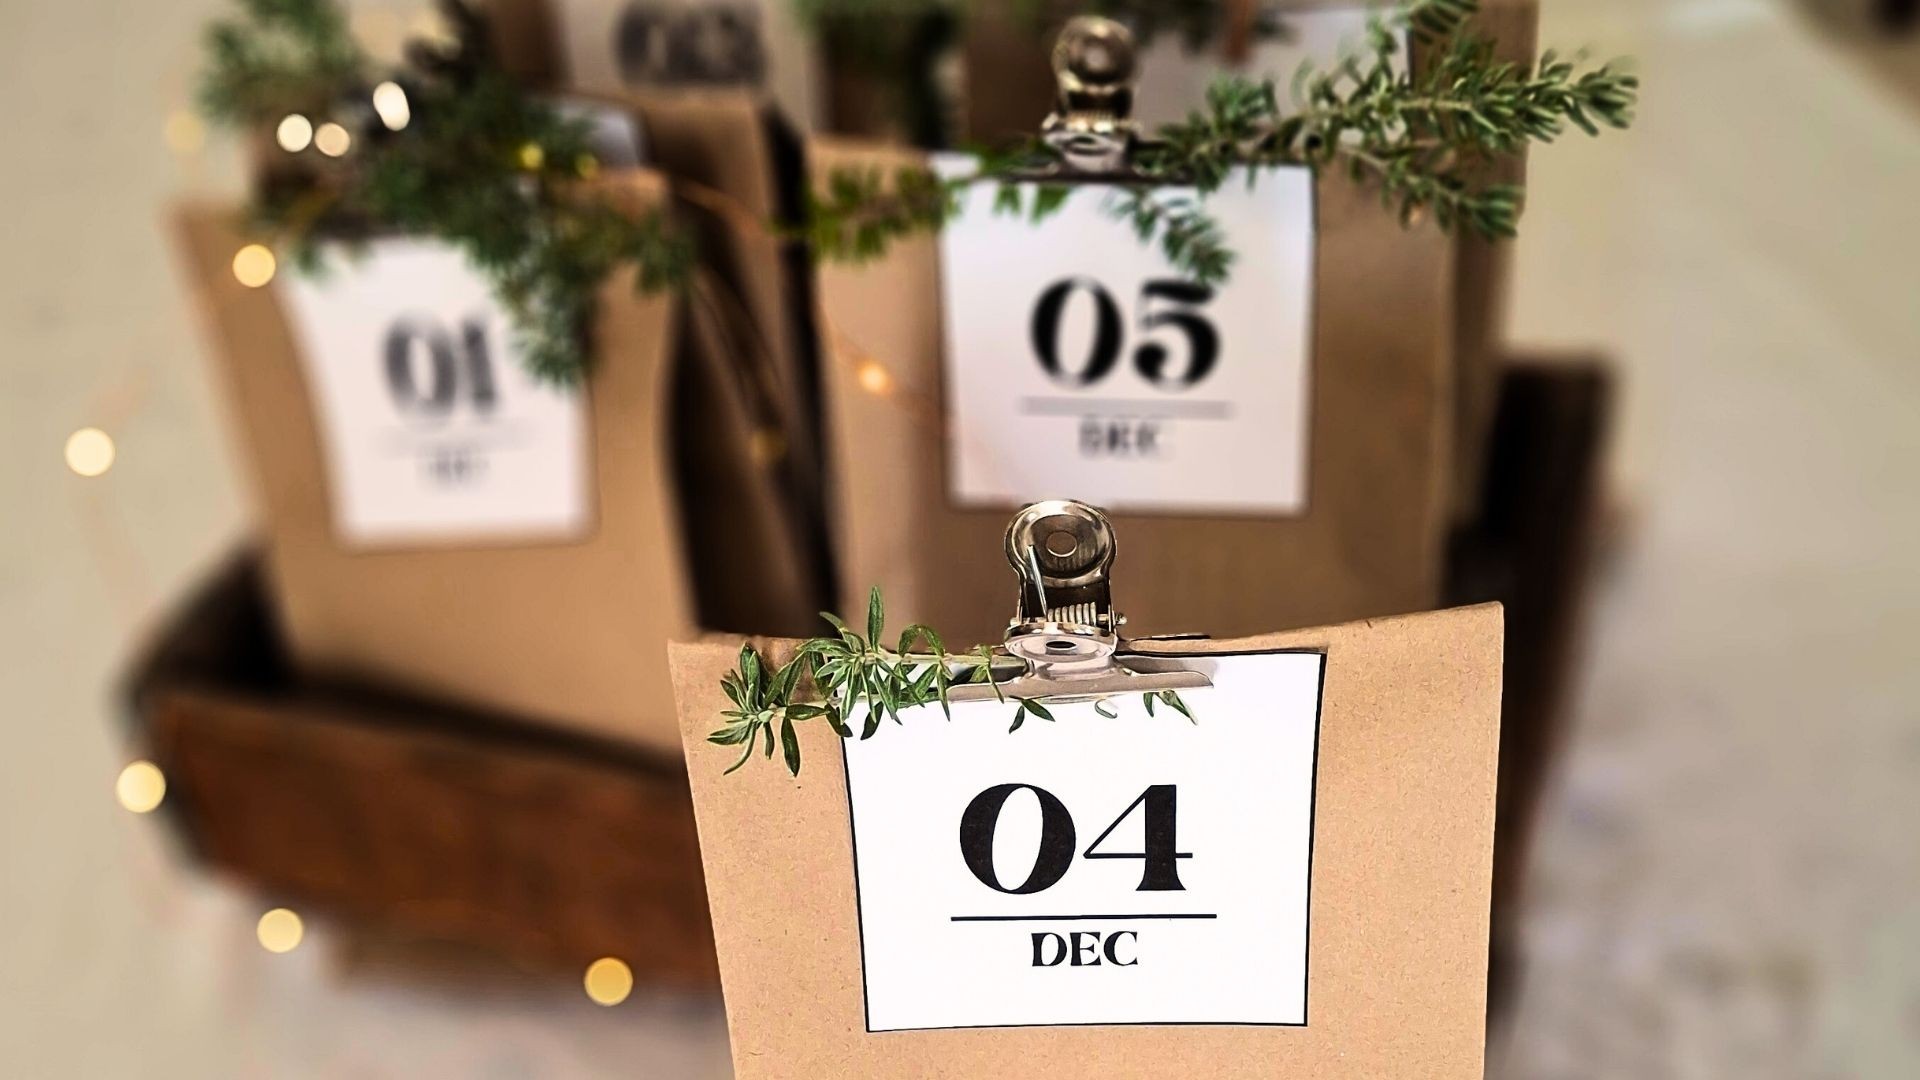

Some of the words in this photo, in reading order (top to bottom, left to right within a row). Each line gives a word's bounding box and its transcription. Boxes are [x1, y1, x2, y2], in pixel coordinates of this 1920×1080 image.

[384, 316, 499, 417] 01
[1030, 277, 1221, 389] 05
[959, 783, 1194, 895] 04
[1031, 931, 1139, 967] DEC
